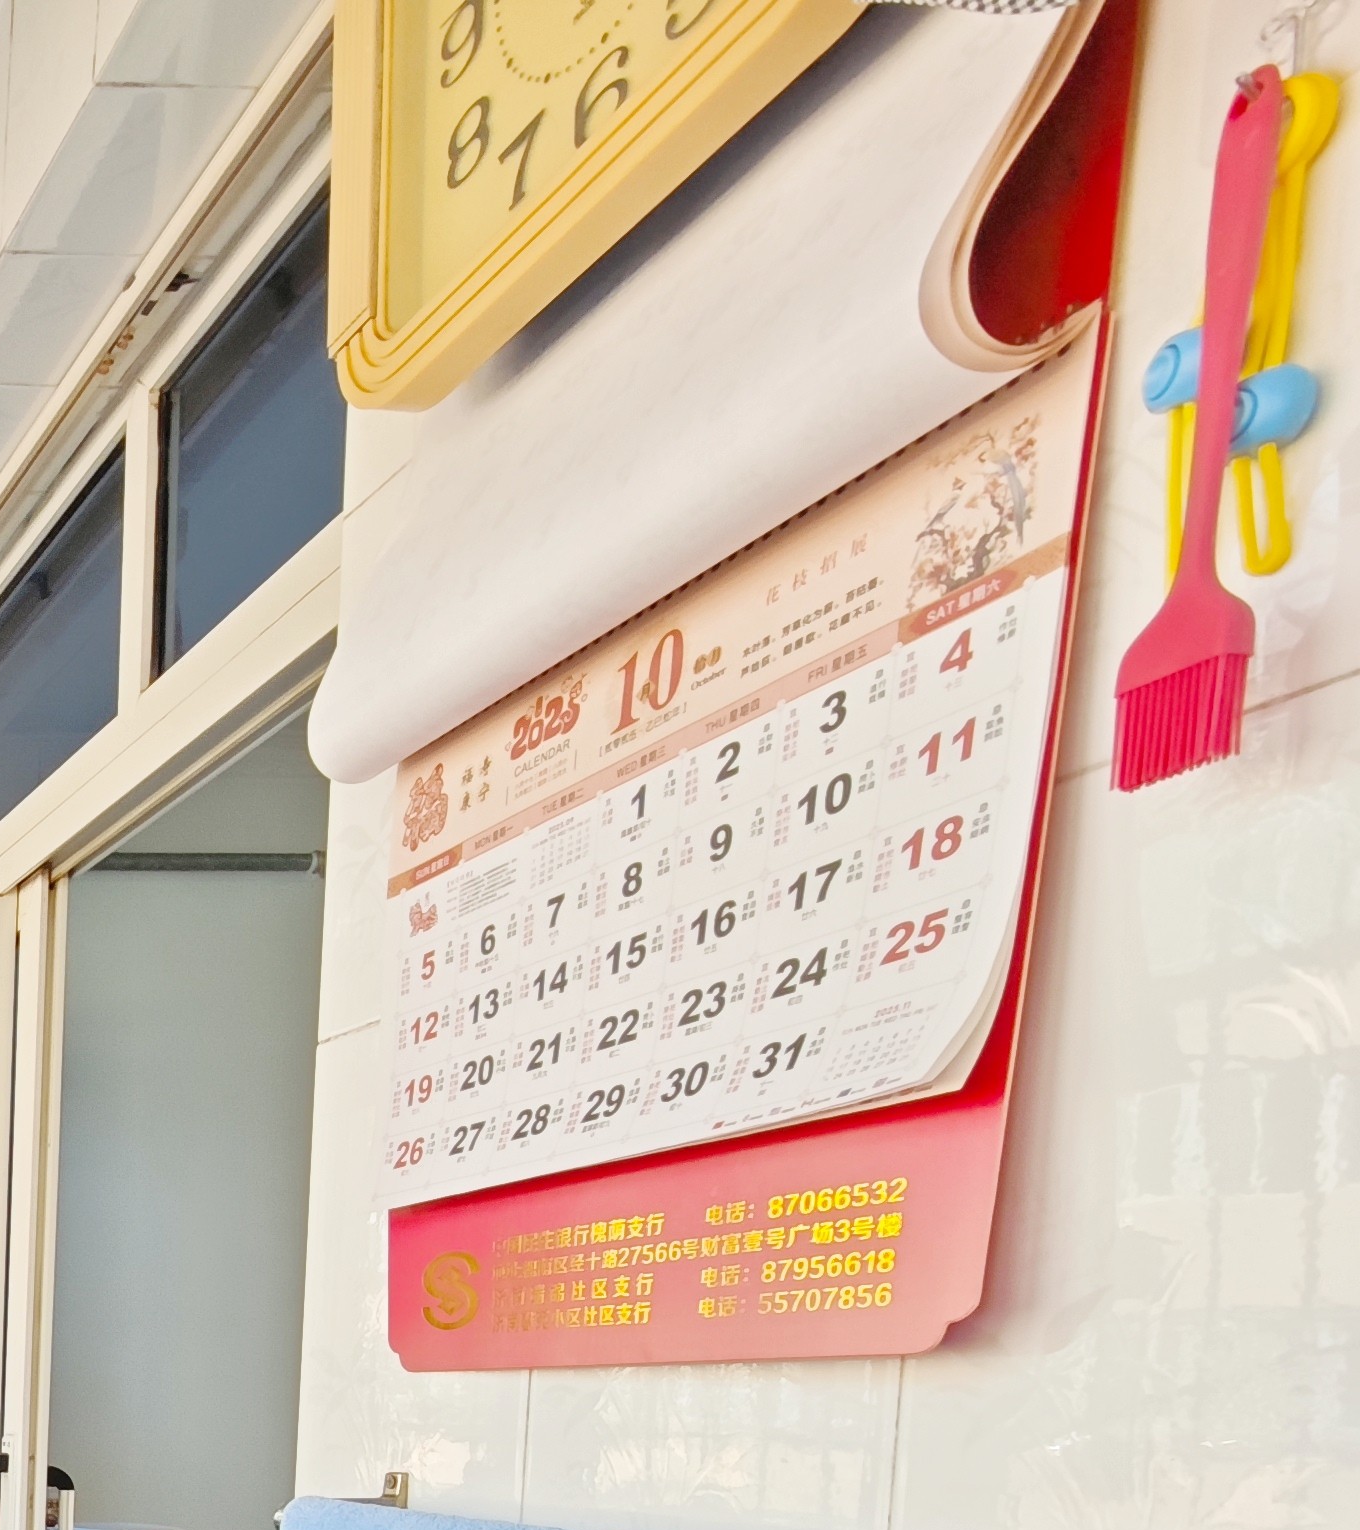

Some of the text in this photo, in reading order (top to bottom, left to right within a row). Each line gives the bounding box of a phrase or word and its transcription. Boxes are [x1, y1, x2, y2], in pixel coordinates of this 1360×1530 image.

[440, 0, 483, 88] 9
[446, 95, 491, 189] 8
[574, 45, 629, 149] 6
[497, 107, 546, 211] 7
[510, 683, 583, 761] 2025
[541, 799, 559, 816] TUE
[616, 762, 639, 780] WED
[639, 744, 668, 769] 星期三
[705, 715, 727, 735] THU
[808, 664, 829, 684] FRI
[831, 643, 869, 674] 星期五
[925, 600, 956, 627] SAT
[957, 577, 1003, 612] 星期六
[609, 628, 684, 736] 10
[630, 784, 647, 820] 1
[715, 741, 741, 784] 2
[819, 690, 847, 734] 3
[939, 628, 974, 674] 4
[690, 667, 727, 691] October
[513, 738, 571, 778] CALENDAR
[421, 949, 436, 981] 5
[480, 923, 496, 956] 6
[547, 893, 566, 929] 7
[621, 861, 643, 898] 8
[709, 823, 734, 863] 9
[797, 772, 853, 825] 10
[918, 716, 977, 776] 11
[410, 1011, 439, 1045] 12
[468, 988, 500, 1024] 13
[533, 961, 569, 1002] 14
[606, 931, 649, 975] 15
[690, 899, 737, 946] 16
[787, 858, 844, 912] 17
[901, 815, 964, 871] 18
[404, 1074, 433, 1107] 19
[459, 1054, 495, 1092] 20
[526, 1031, 562, 1072] 21
[596, 1008, 640, 1051] 22
[677, 980, 727, 1027] 23
[770, 946, 828, 999] 24
[879, 907, 949, 967] 25
[392, 1137, 425, 1170] 26
[448, 1120, 486, 1156] 27
[510, 1103, 551, 1141] 28
[580, 1083, 626, 1124] 29
[660, 1060, 710, 1103] 30
[752, 1032, 807, 1079] 31
[766, 1177, 909, 1220] 87066532
[756, 1282, 894, 1315] 55707856
[760, 1248, 897, 1284] 87956618
